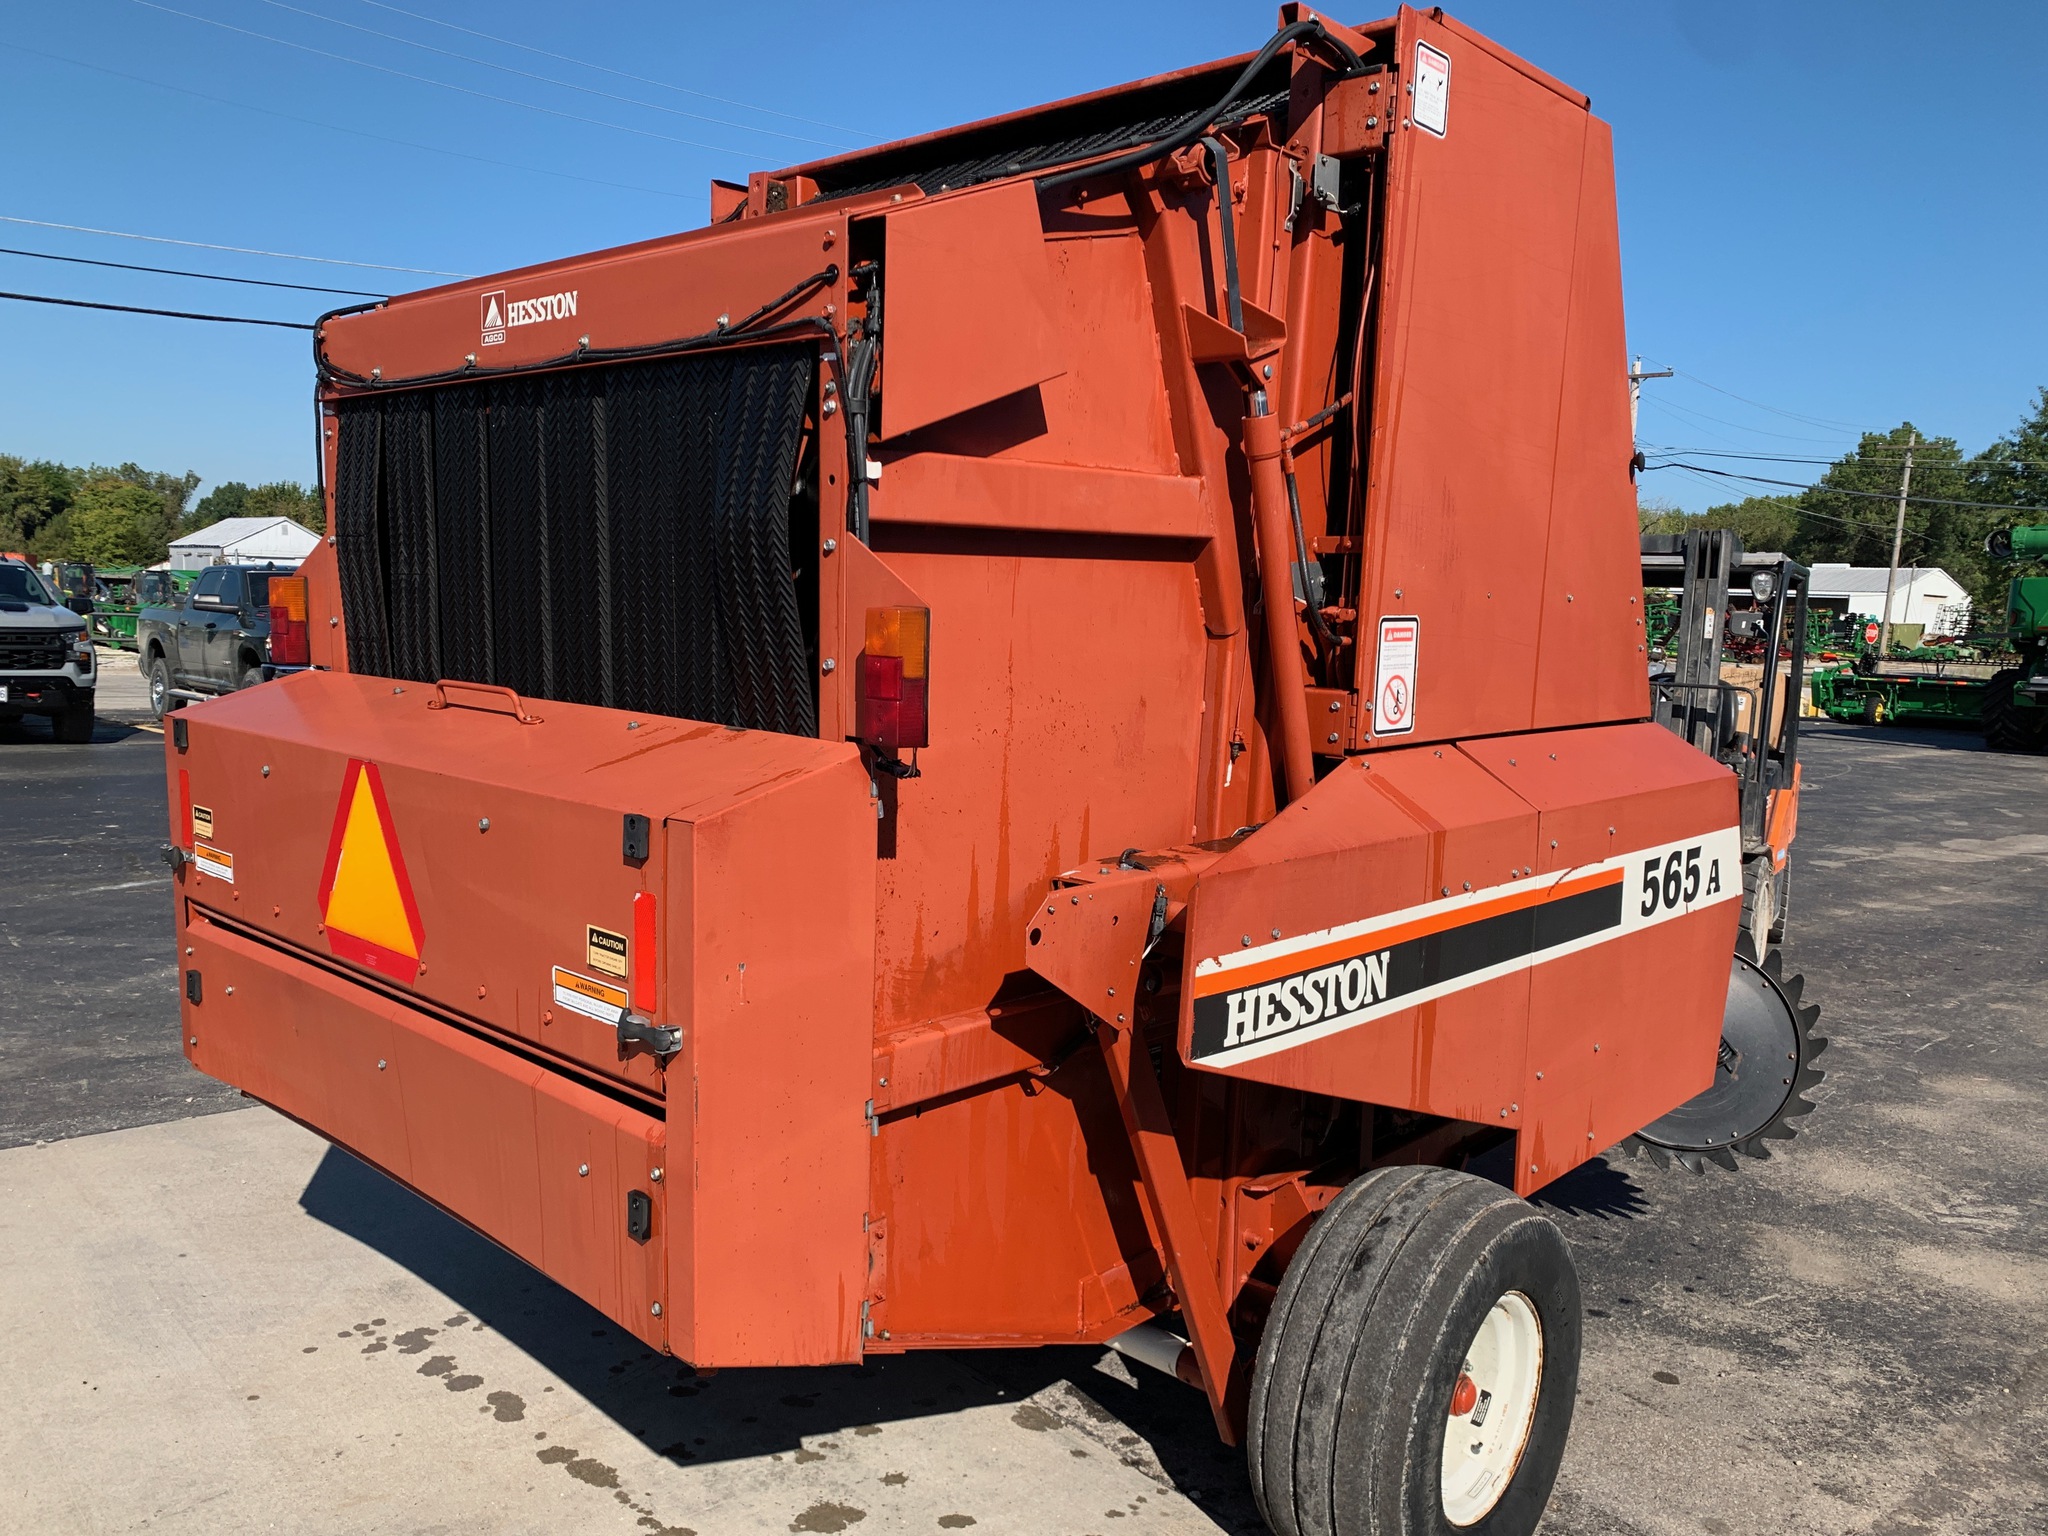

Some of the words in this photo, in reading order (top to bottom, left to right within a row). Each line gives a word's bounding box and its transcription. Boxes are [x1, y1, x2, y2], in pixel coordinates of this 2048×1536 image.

[507, 291, 578, 327] HESSTON
[484, 333, 503, 343] AGCO
[1393, 631, 1412, 639] DANGER
[1866, 629, 1878, 637] STOP
[1641, 845, 1702, 917] 565
[1706, 858, 1720, 896] A
[598, 936, 624, 951] CAUTION
[579, 982, 605, 997] WARNING
[1223, 951, 1390, 1048] HESSTON
